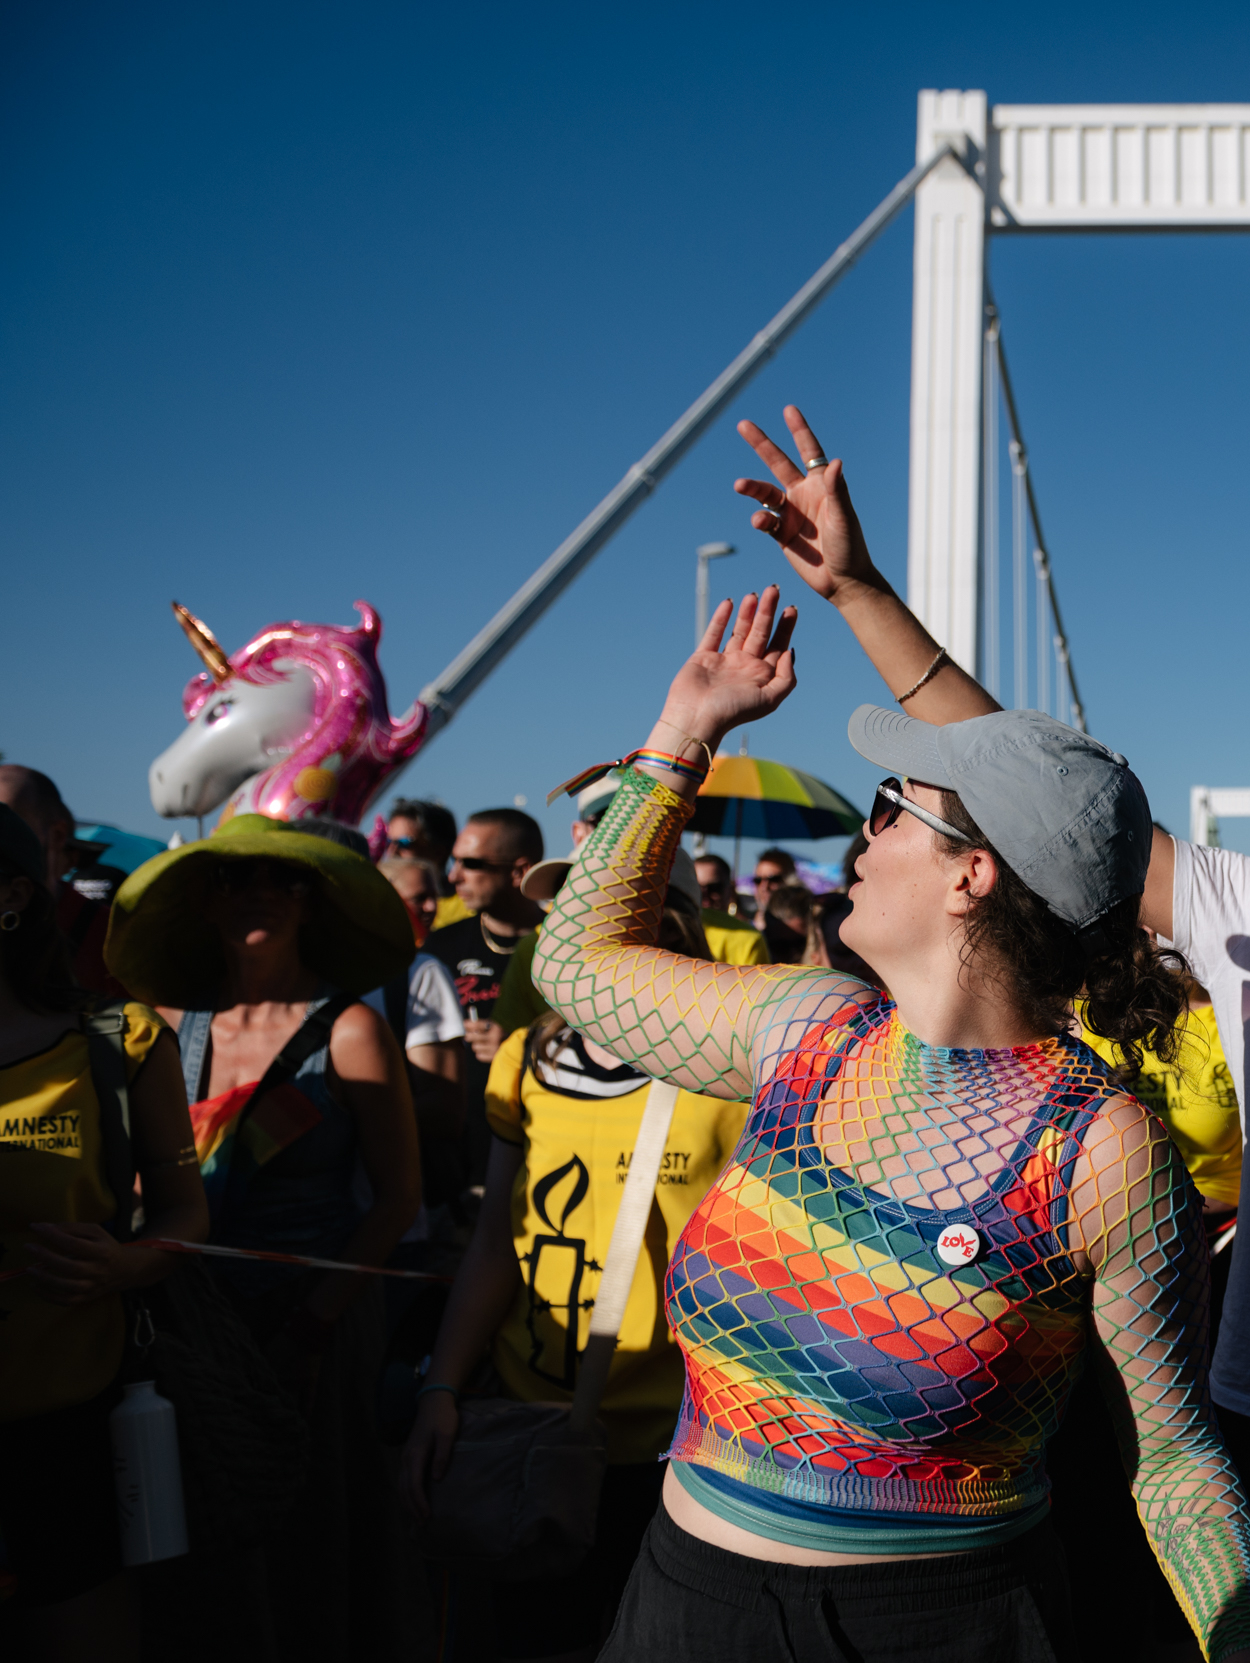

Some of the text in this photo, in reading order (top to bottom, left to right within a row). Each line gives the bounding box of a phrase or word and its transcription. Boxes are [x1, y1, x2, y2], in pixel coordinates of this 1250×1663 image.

[1133, 1071, 1182, 1093] ESTY
[0, 1115, 79, 1137] MNESTY
[616, 1152, 691, 1169] ASTY
[941, 1232, 976, 1258] LOVE
